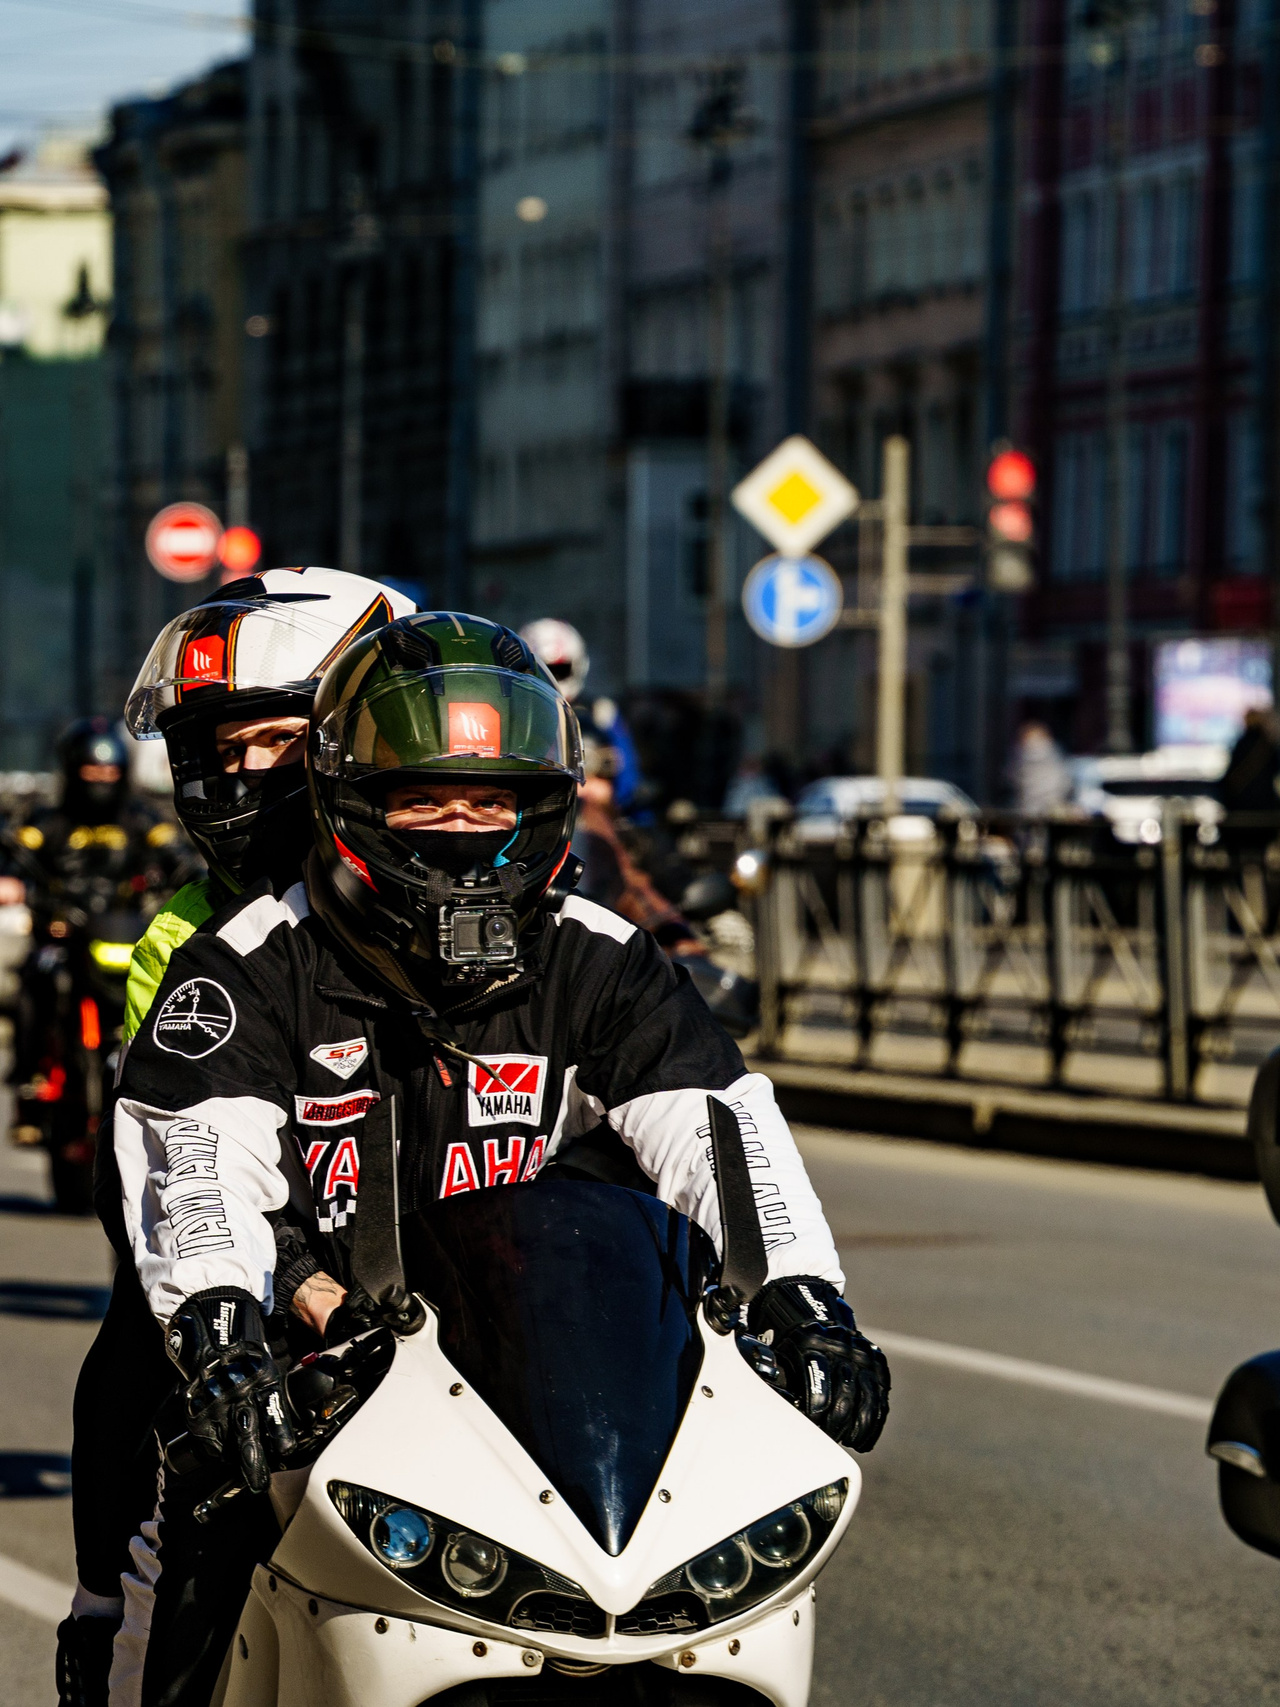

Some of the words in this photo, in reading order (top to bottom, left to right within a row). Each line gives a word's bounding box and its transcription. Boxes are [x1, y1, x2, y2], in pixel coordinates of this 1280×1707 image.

[159, 1023, 192, 1031] YAMAHA
[325, 1044, 364, 1060] SP
[477, 1094, 532, 1117] YAMAHA
[293, 1134, 549, 1200] YAAHA
